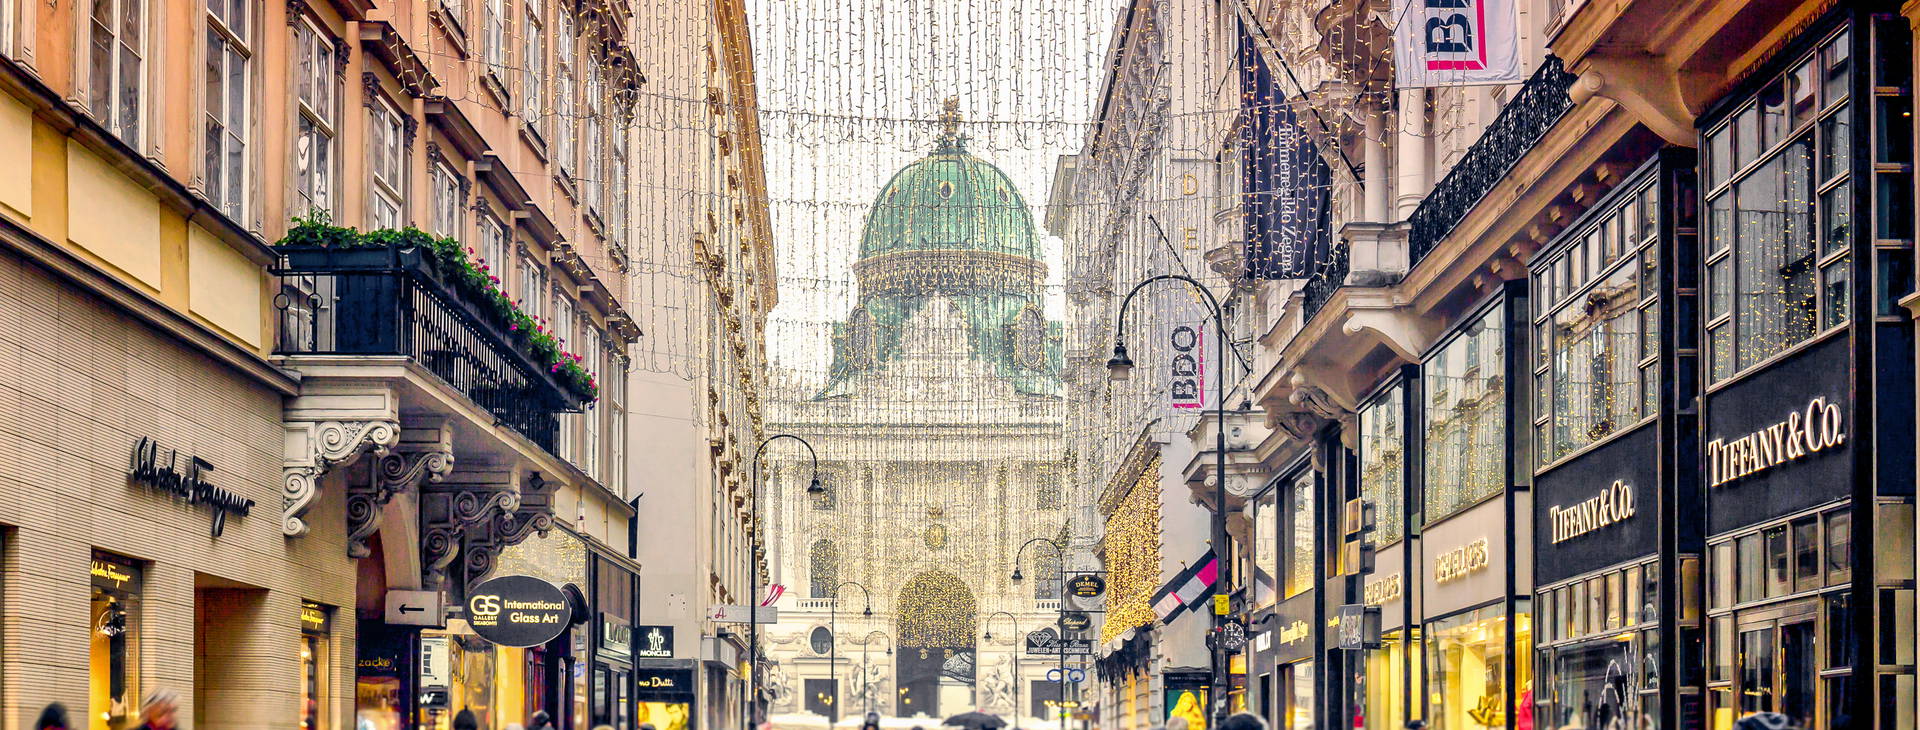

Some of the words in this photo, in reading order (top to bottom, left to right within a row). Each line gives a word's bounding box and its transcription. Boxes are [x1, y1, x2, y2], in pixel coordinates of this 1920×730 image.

[1277, 225, 1297, 272] Zegna
[1171, 325, 1198, 400] BDO
[470, 594, 501, 616] GS
[504, 599, 565, 610] International
[510, 612, 540, 624] Glass
[542, 612, 559, 624] Art
[651, 676, 674, 688] Dutti
